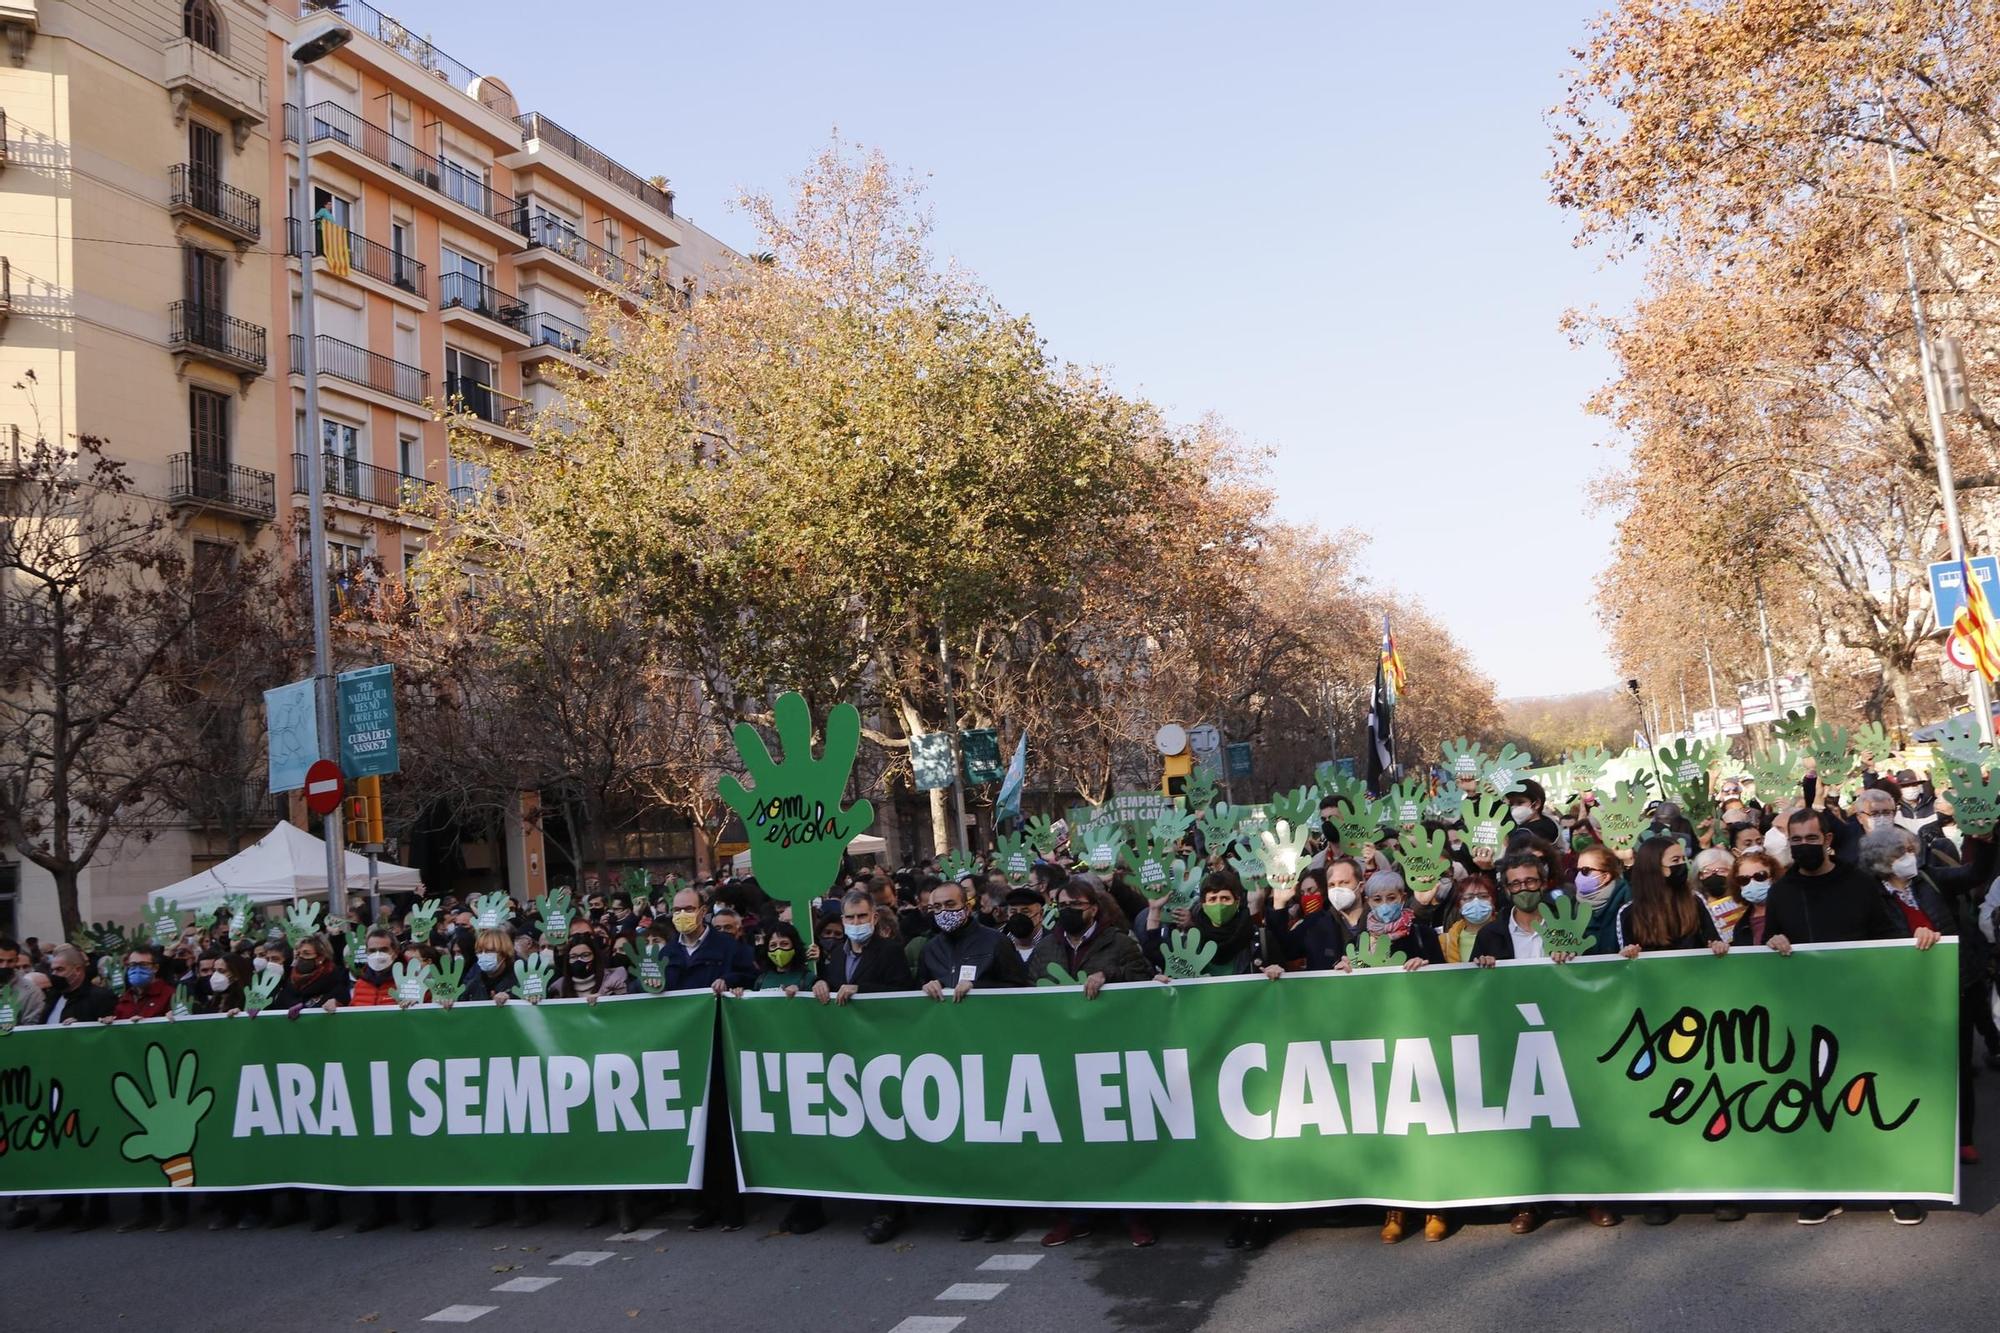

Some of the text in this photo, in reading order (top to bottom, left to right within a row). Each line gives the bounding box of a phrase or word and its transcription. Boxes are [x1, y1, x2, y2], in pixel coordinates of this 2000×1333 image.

[348, 729, 391, 744] CURSA DELS
[353, 740, 379, 754] NASSOS
[747, 794, 811, 827] som
[764, 800, 849, 848] escola
[1121, 809, 1136, 821] EN
[1597, 1005, 1795, 1081] som
[740, 1003, 1581, 1143] L'ESCOLA EN CATALÀ
[1649, 1025, 1920, 1142] escola
[233, 1050, 704, 1147] ARA I SEMPRE,
